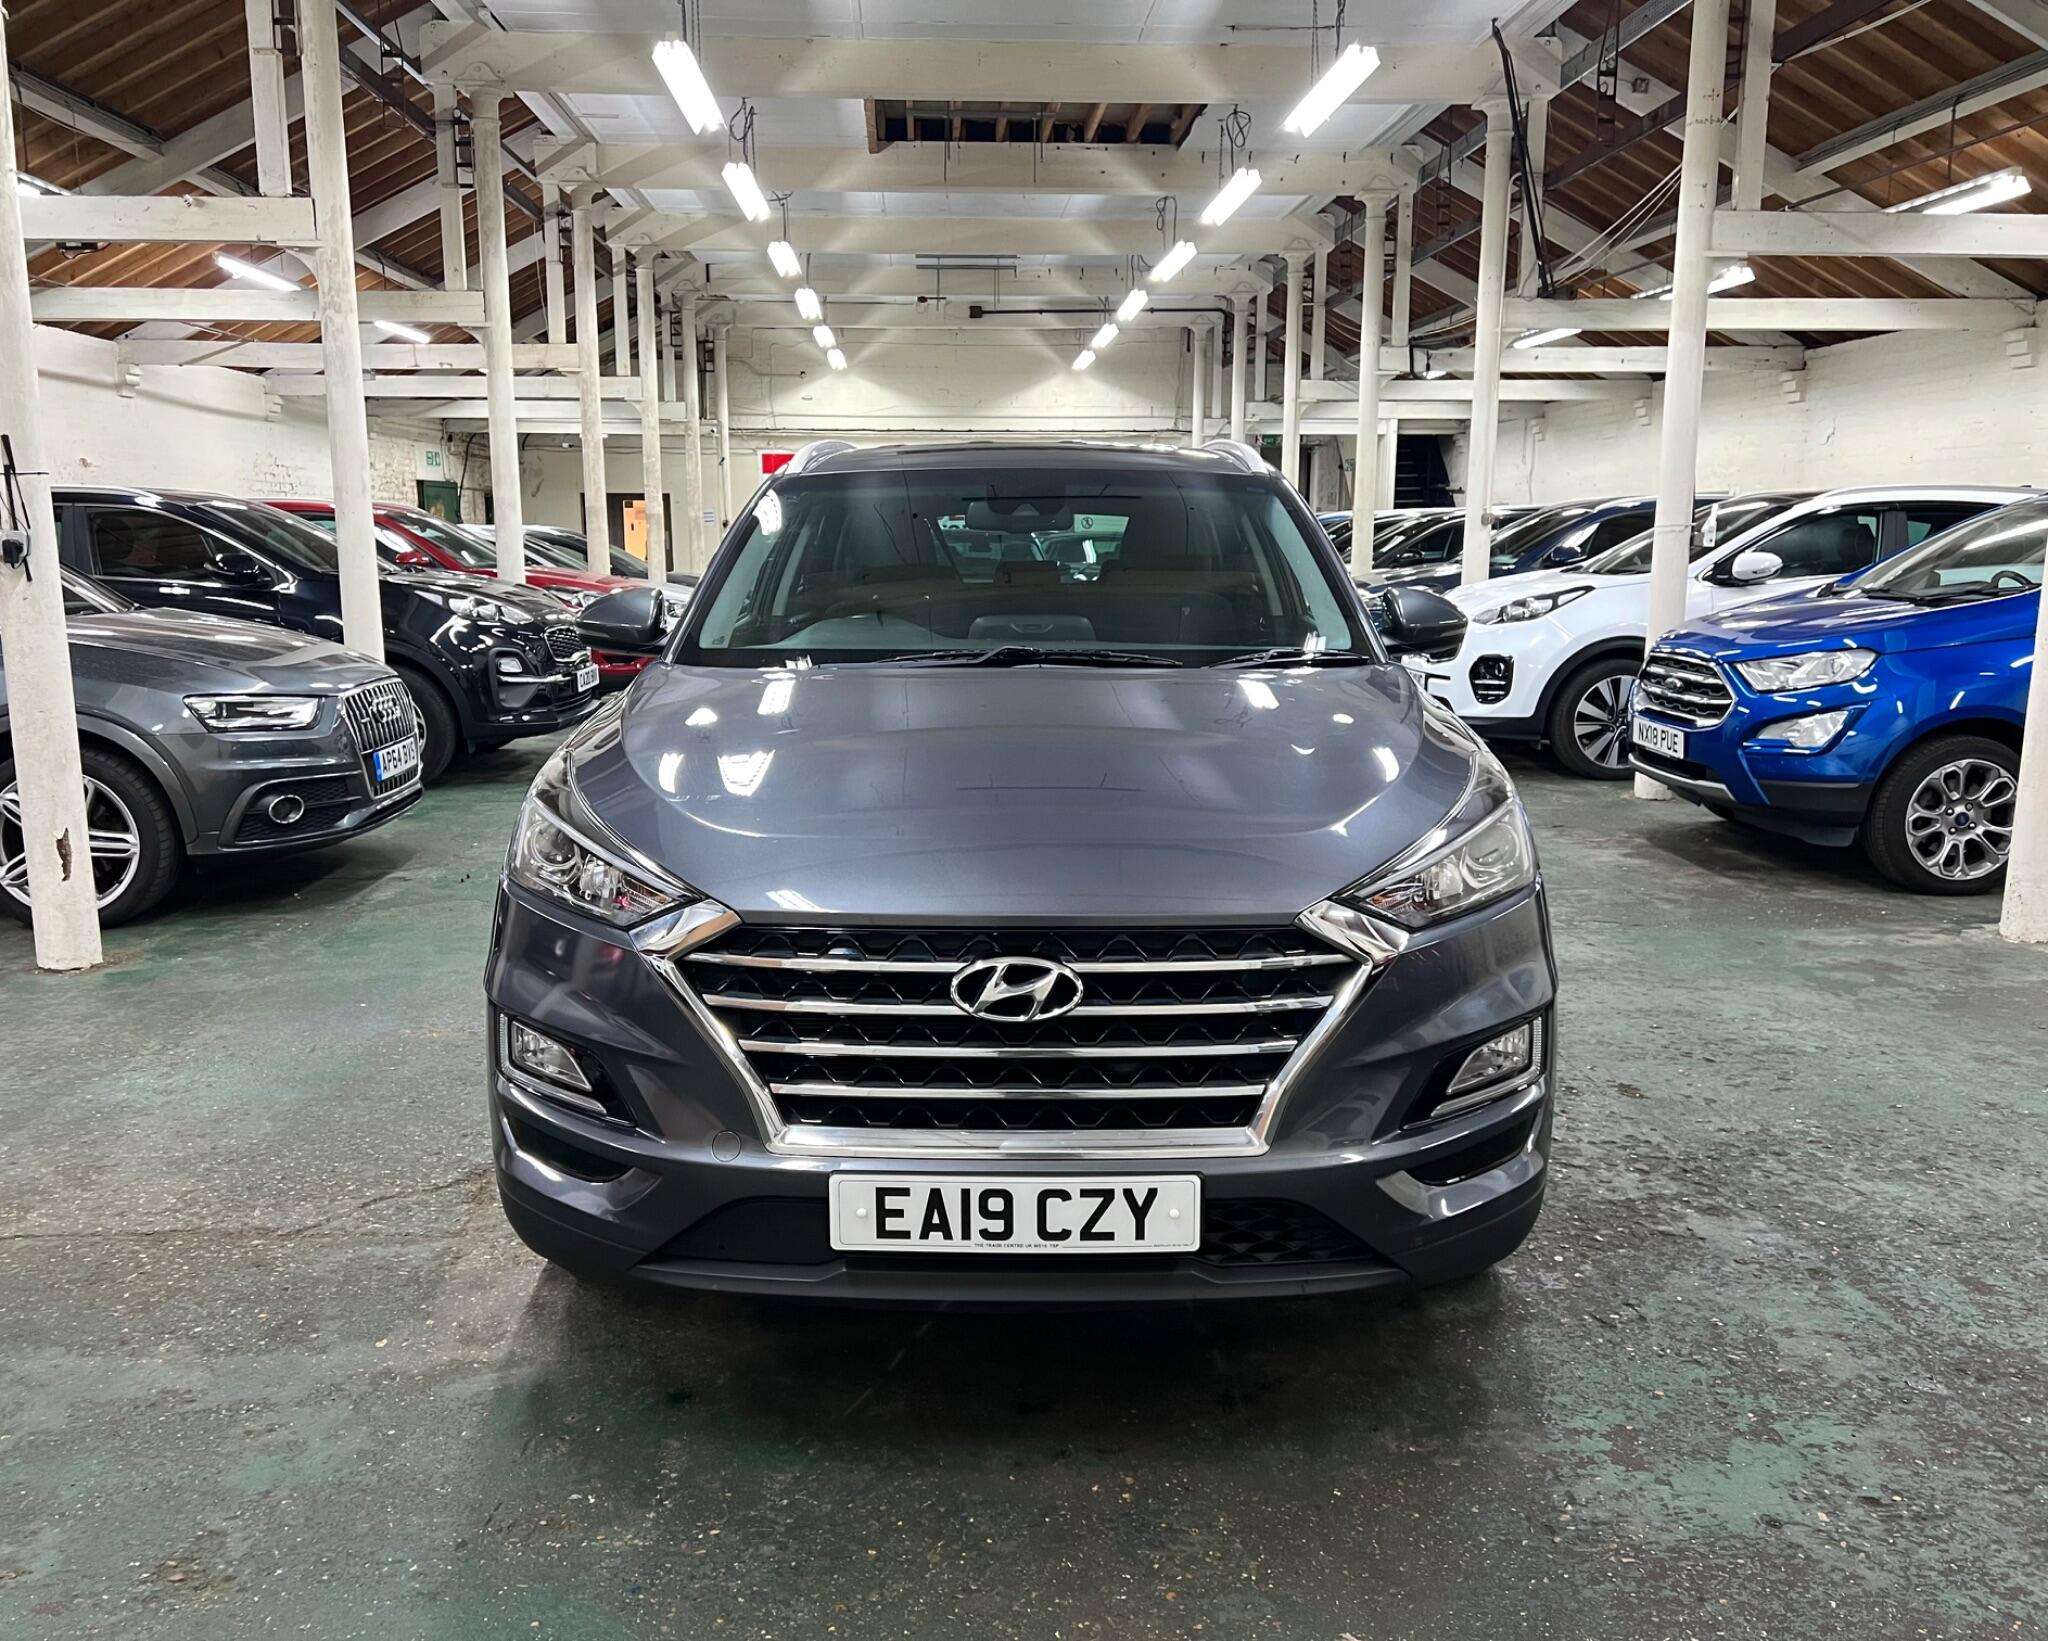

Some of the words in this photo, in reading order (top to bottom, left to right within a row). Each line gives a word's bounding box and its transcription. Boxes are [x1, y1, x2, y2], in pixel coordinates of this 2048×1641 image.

[1639, 723, 1658, 746] NX18
[1660, 730, 1678, 753] PUE
[382, 747, 401, 773] AP64
[875, 1187, 1014, 1242] EA19
[1036, 1188, 1159, 1242] CZY
